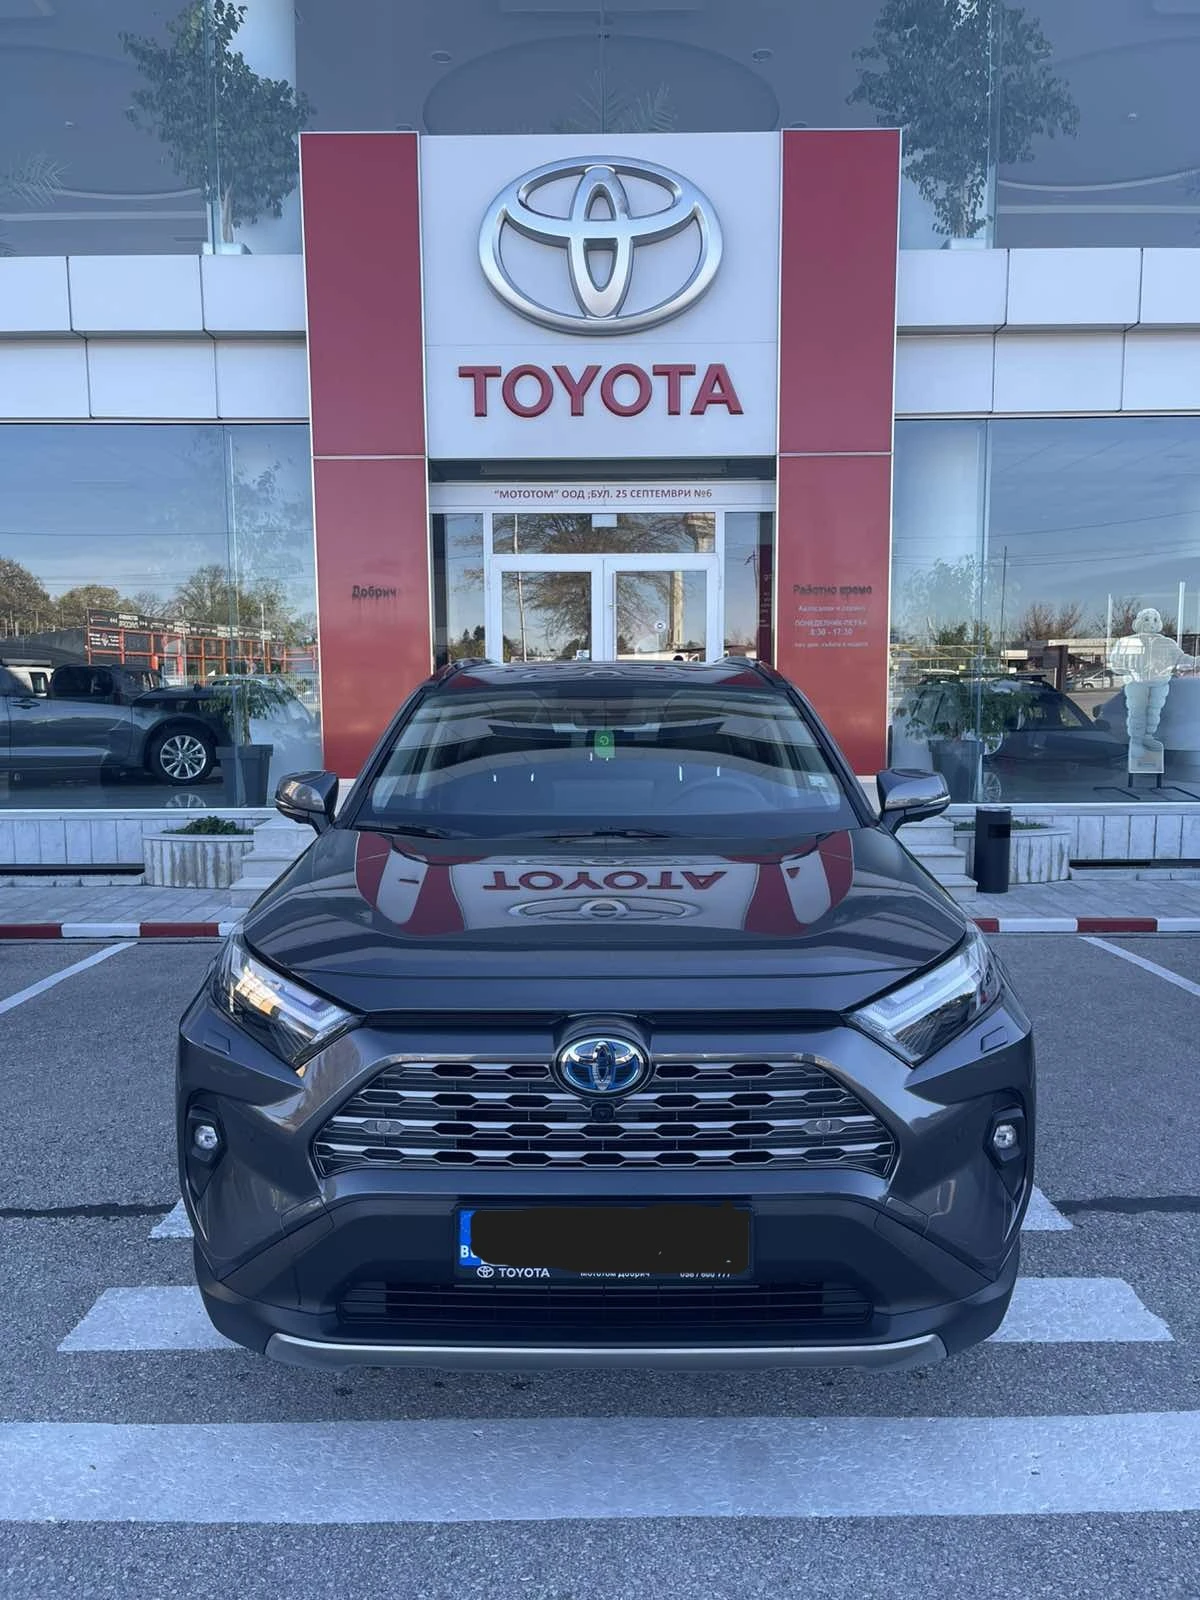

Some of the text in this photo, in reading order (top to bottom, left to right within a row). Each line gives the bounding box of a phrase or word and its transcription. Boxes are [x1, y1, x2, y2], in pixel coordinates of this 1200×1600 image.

[458, 363, 744, 418] TOYOTA
[561, 489, 585, 499] ООД
[615, 489, 628, 498] 25
[630, 489, 691, 498] СЕПТЕМВРИ
[694, 488, 713, 498] №6
[352, 584, 397, 600] Добрич
[498, 1267, 551, 1278] TOYOTA
